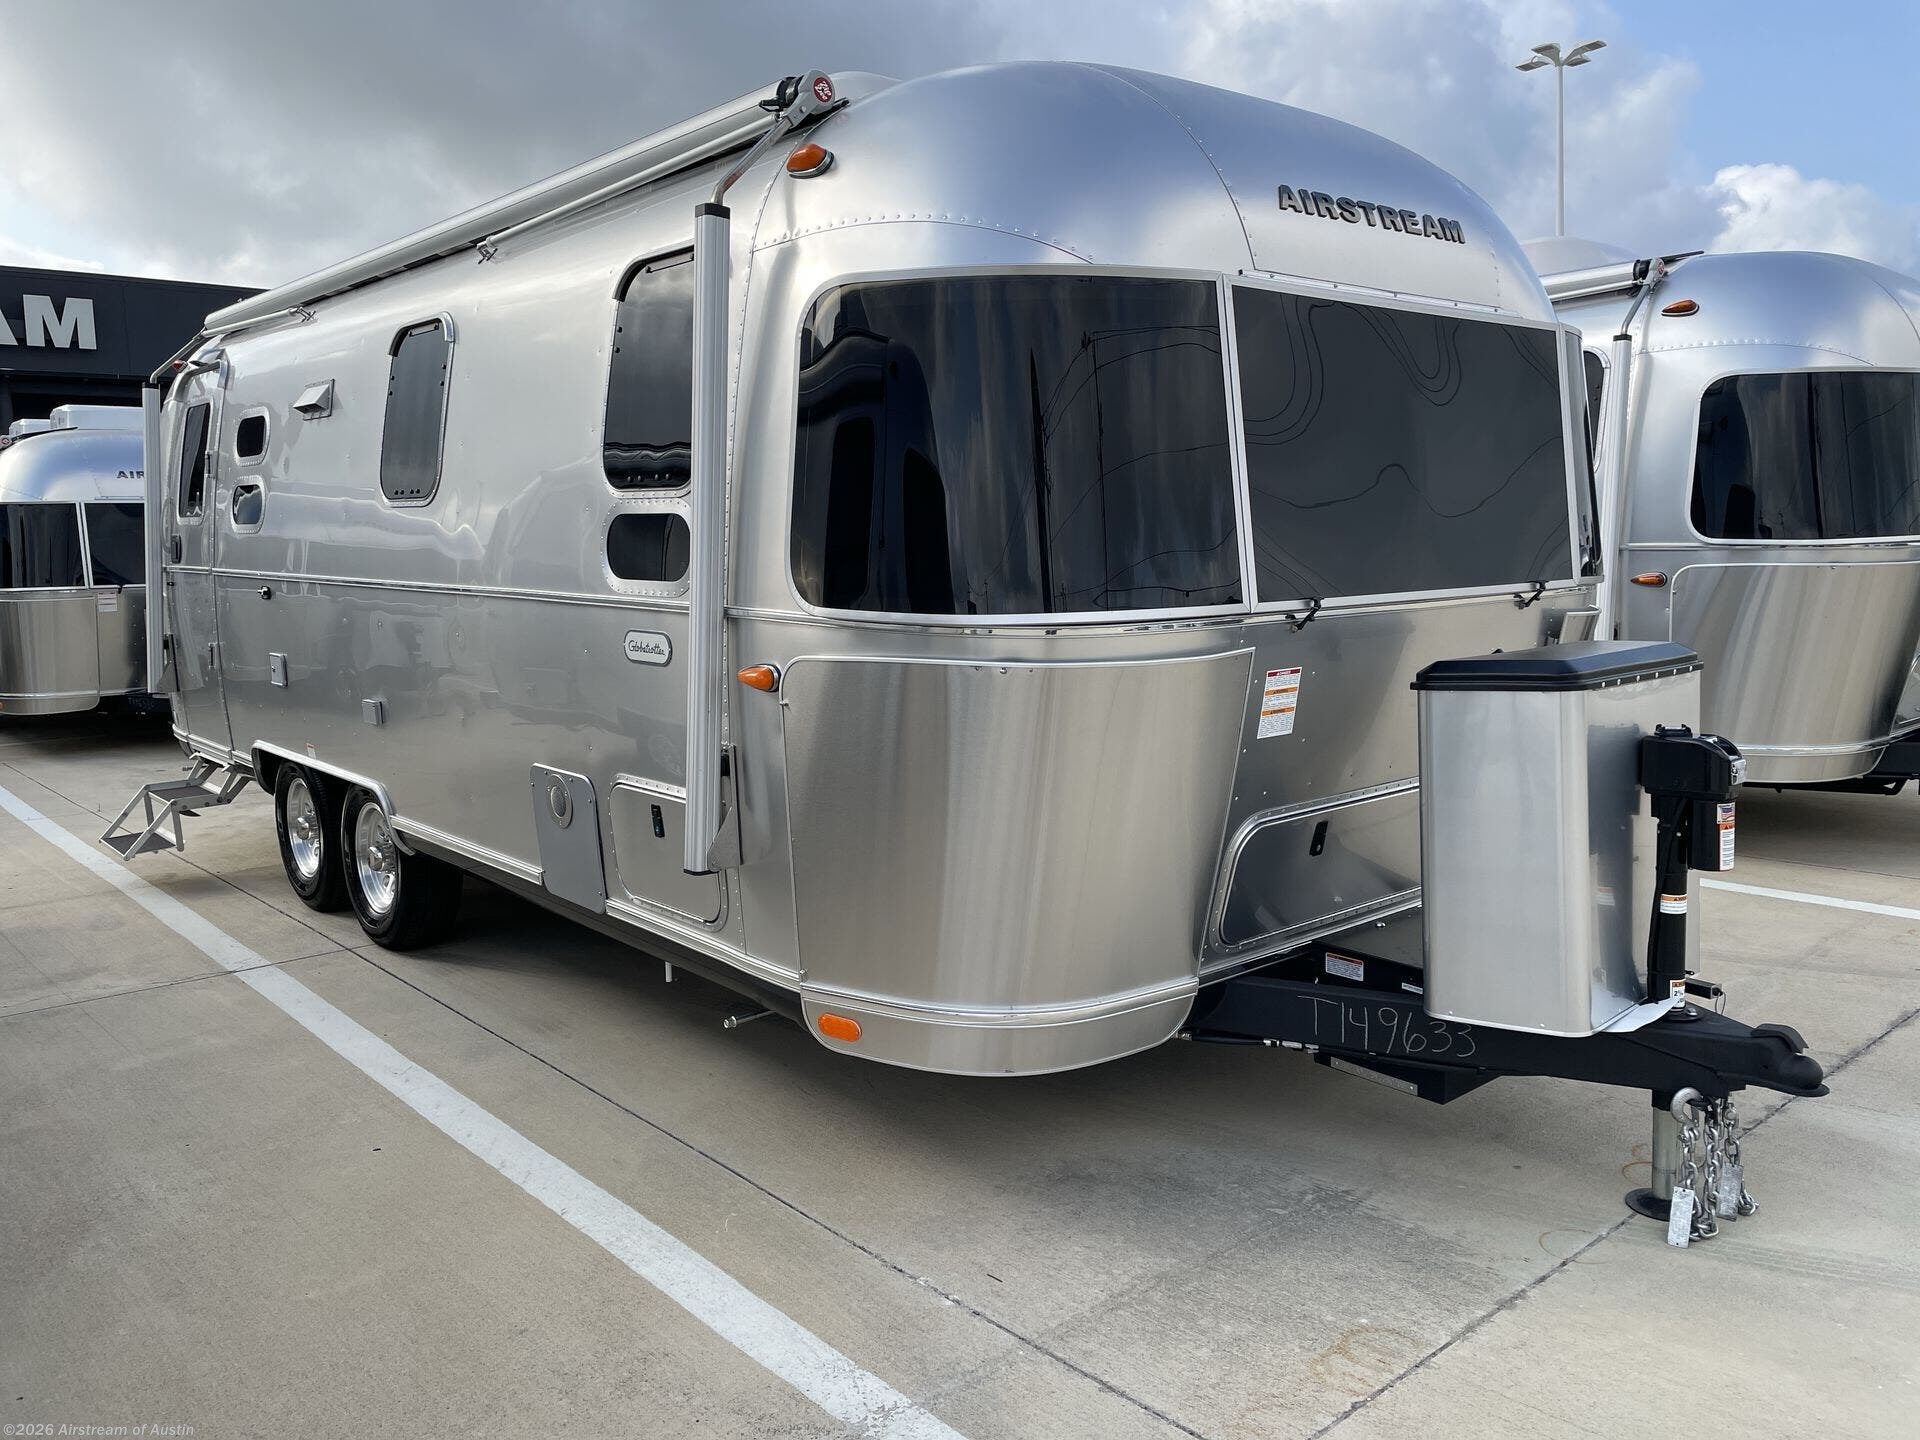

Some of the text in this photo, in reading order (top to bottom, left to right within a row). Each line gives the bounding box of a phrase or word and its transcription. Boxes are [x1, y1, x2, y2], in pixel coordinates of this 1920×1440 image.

[1278, 184, 1466, 245] AIRSTREAM
[0, 294, 97, 350] M
[1297, 995, 1476, 1058] T149633
